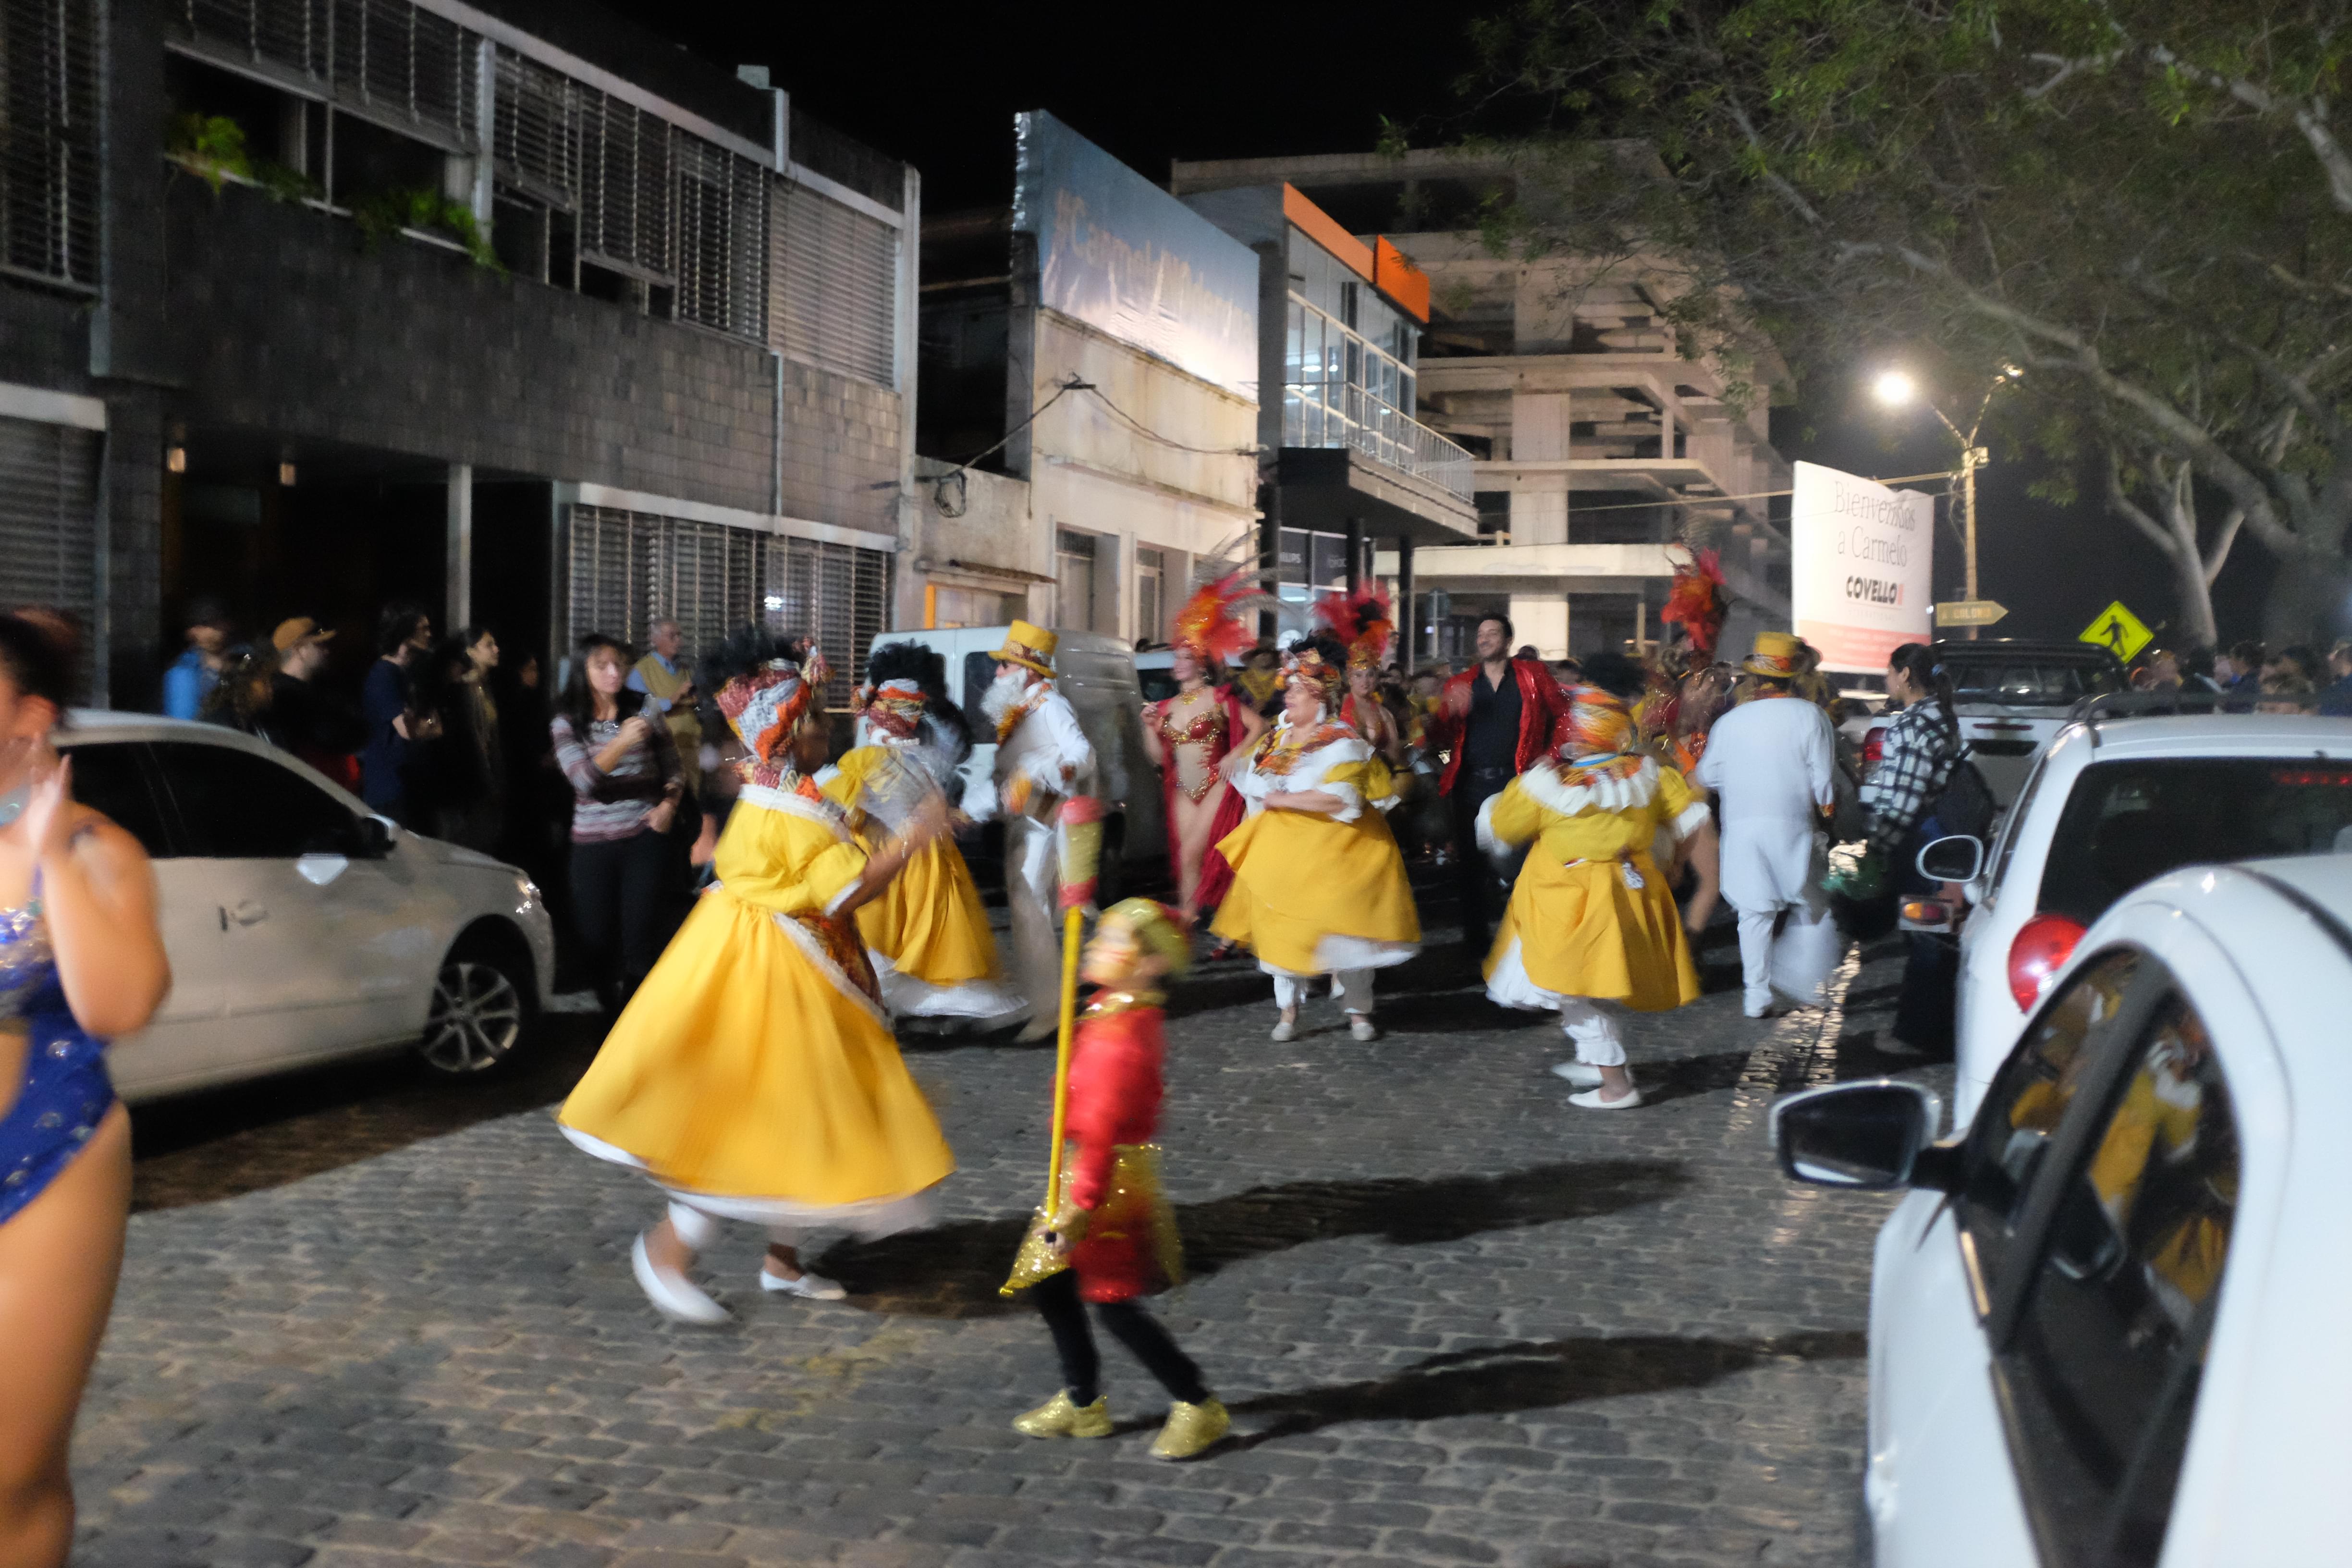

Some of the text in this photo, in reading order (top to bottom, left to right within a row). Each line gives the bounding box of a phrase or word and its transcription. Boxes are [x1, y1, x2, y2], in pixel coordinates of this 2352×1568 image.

[1835, 481, 1915, 531] Bienvenidos
[1838, 526, 1907, 567] a Carmelo
[1846, 576, 1898, 604] COVELLO
